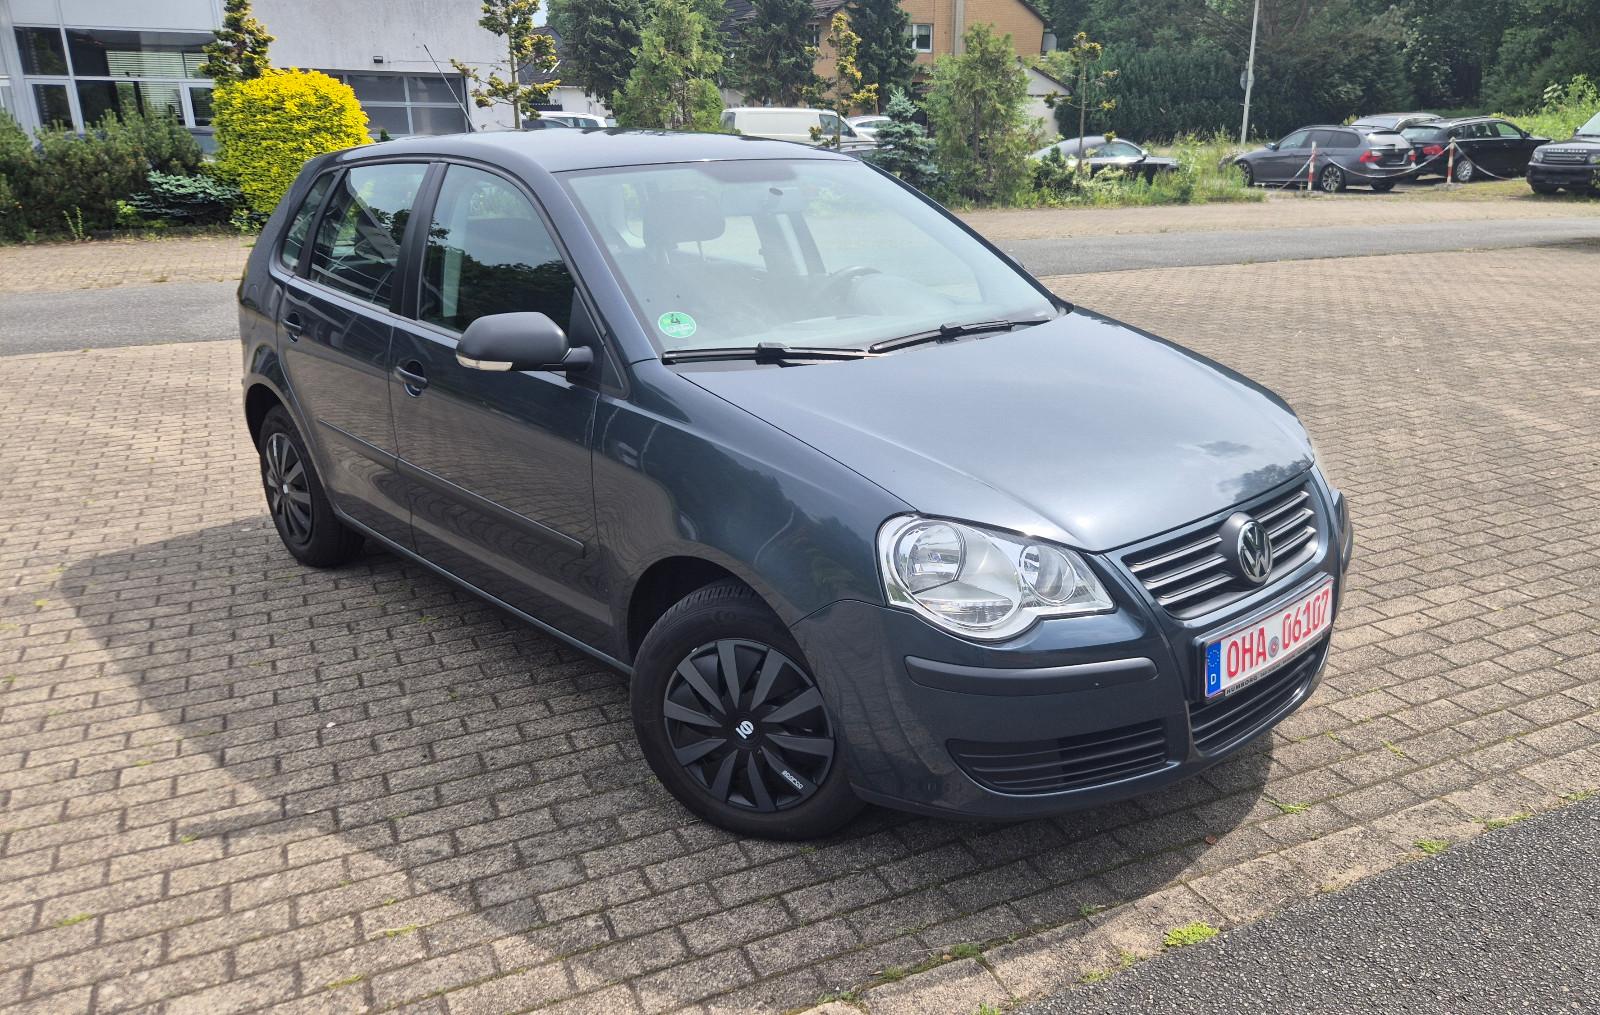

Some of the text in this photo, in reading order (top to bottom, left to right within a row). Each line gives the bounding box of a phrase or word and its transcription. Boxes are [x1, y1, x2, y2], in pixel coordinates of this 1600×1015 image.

[1226, 627, 1267, 679] OHA
[1282, 588, 1330, 650] 06107
[1210, 673, 1217, 686] D
